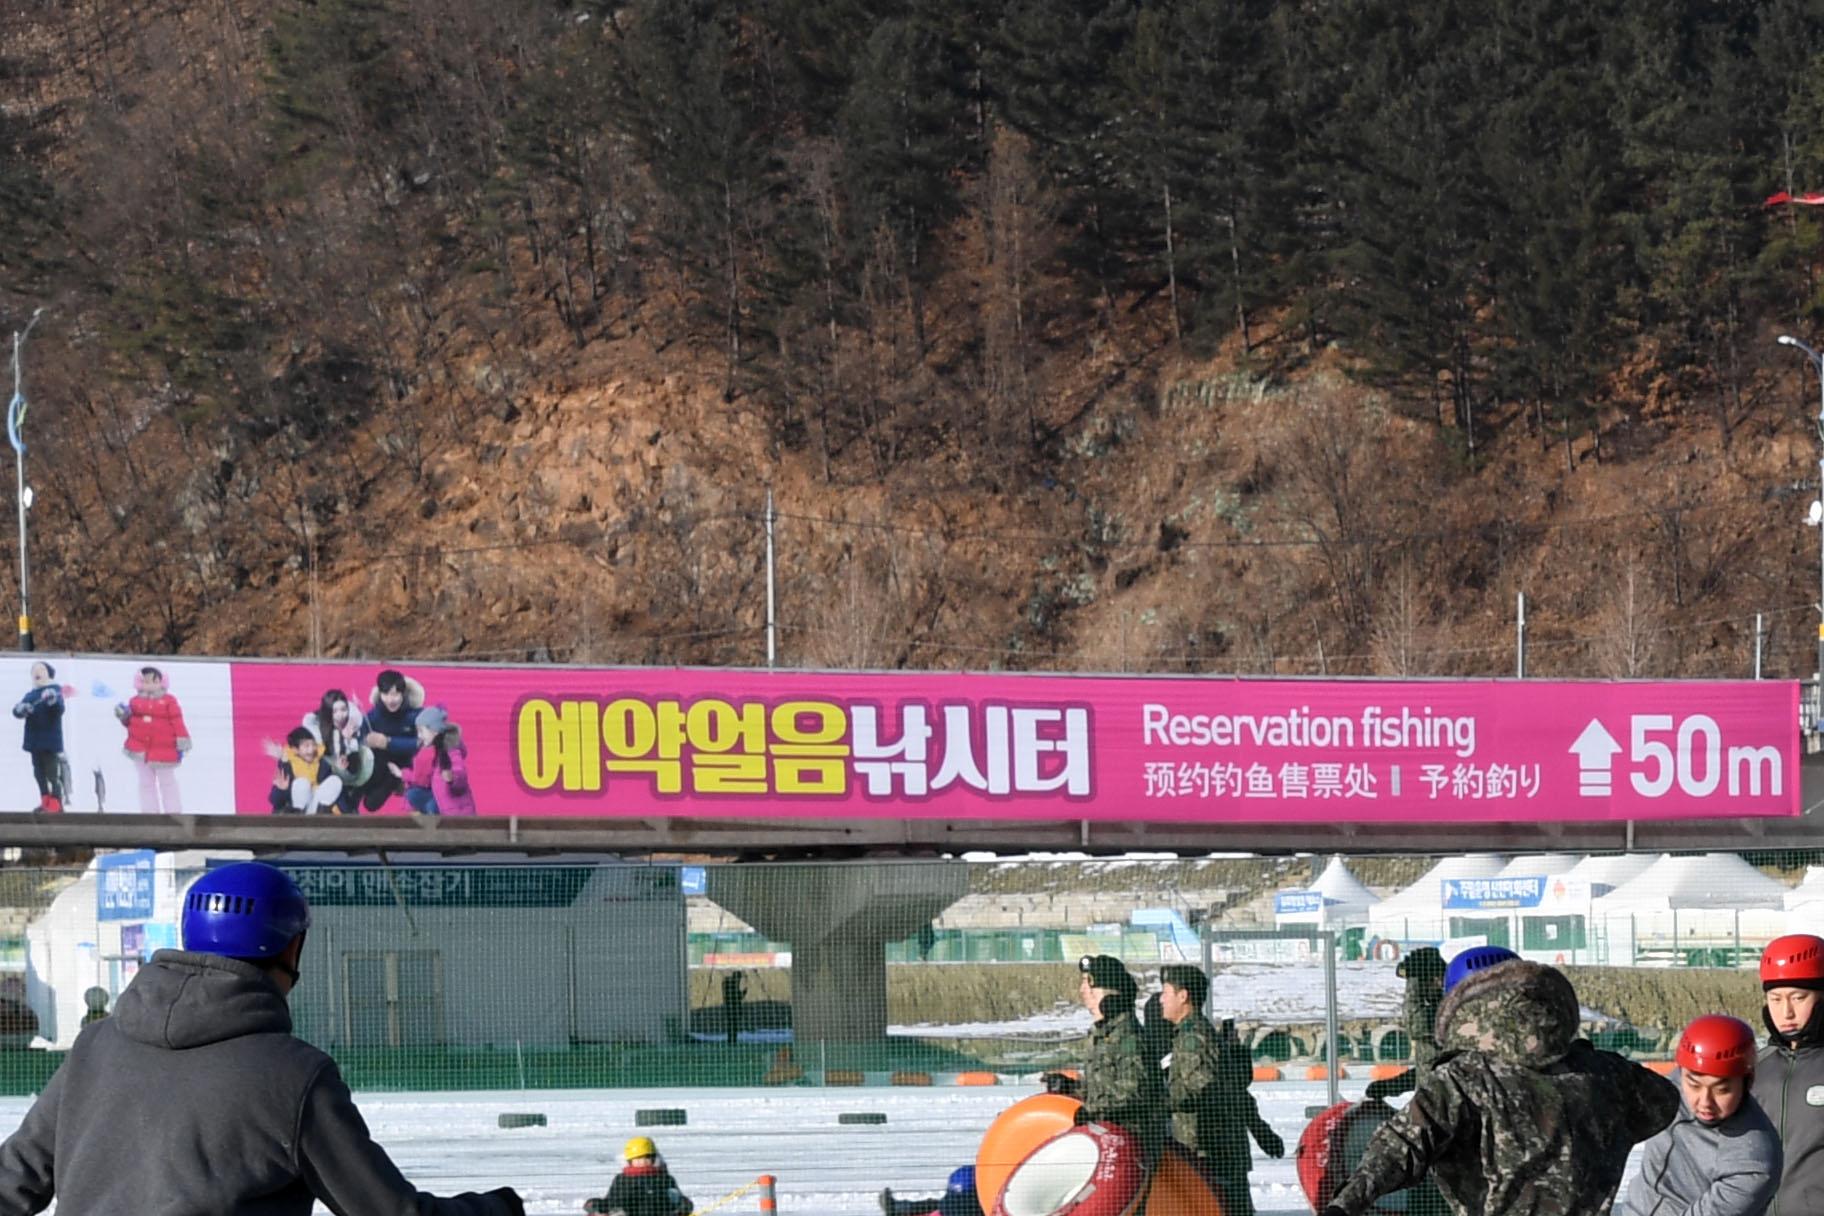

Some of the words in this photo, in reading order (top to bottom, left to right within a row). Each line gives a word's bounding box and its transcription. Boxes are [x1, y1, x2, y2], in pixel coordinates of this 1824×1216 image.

[517, 698, 1091, 796] 예약얼음낚시터
[1143, 704, 1354, 747] Reservation
[1361, 706, 1476, 757] fishing
[1629, 714, 1783, 797] 50m
[1143, 762, 1378, 799] 预约钓鱼售票处
[1418, 763, 1542, 799] 予約釣り
